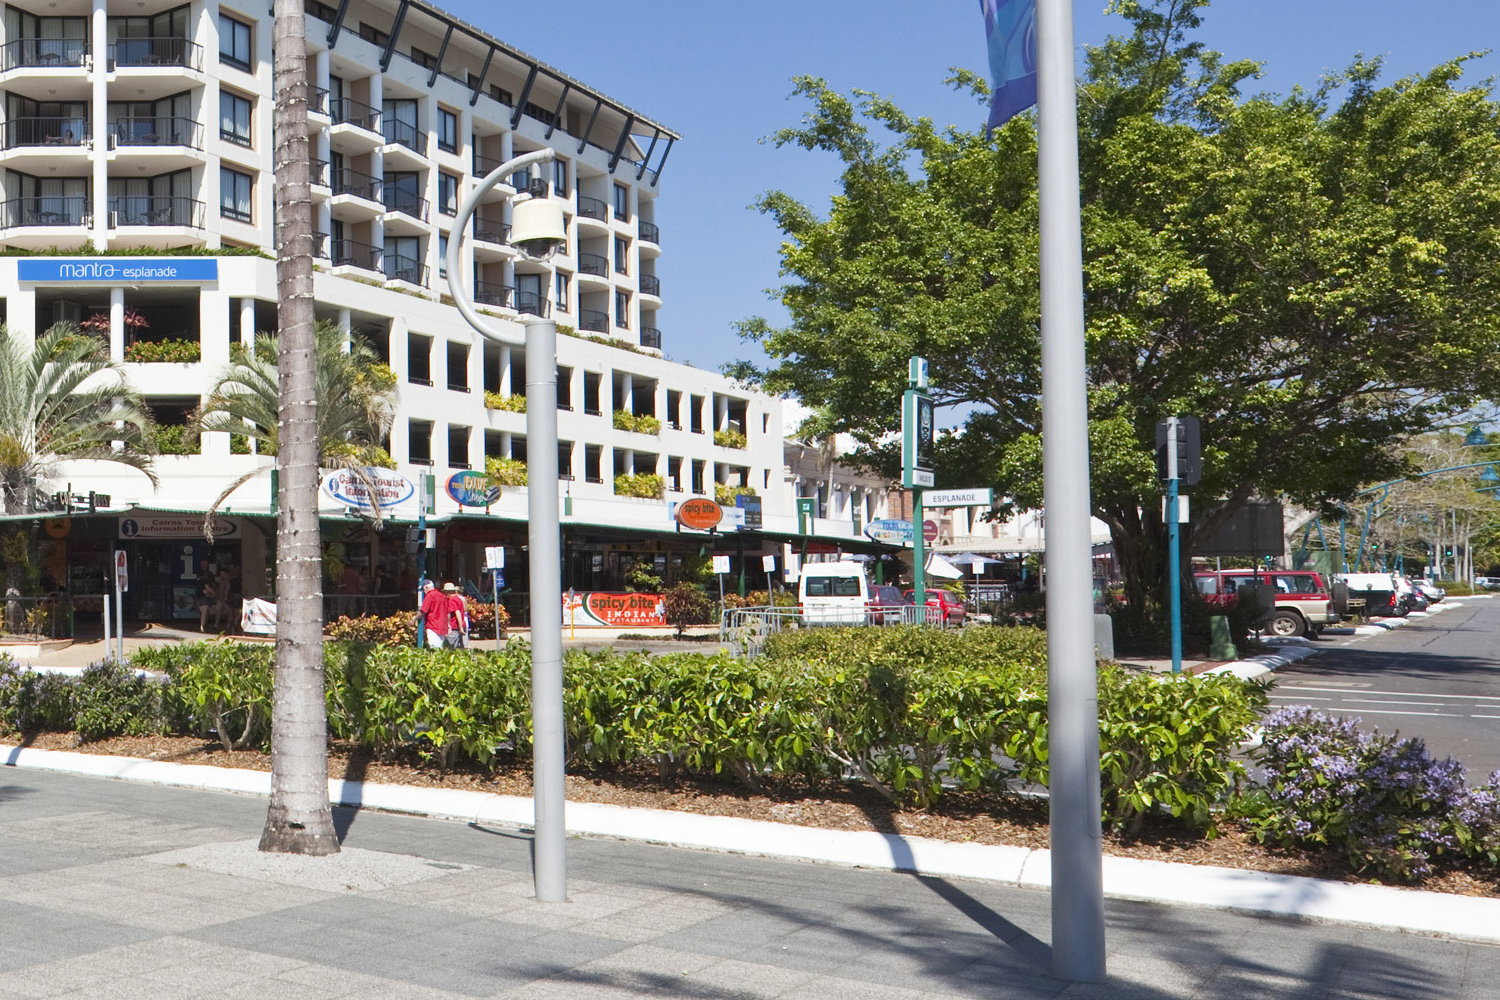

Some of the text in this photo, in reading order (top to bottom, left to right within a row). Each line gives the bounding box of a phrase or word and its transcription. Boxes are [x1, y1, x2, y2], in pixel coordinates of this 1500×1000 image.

[60, 262, 177, 279] mantra esplanade
[371, 476, 405, 488] Tourist
[464, 475, 488, 492] DIVE
[933, 494, 976, 502] ESPLANADE
[685, 502, 715, 515] spicy bite
[592, 596, 625, 611] spicy
[630, 596, 654, 609] bite
